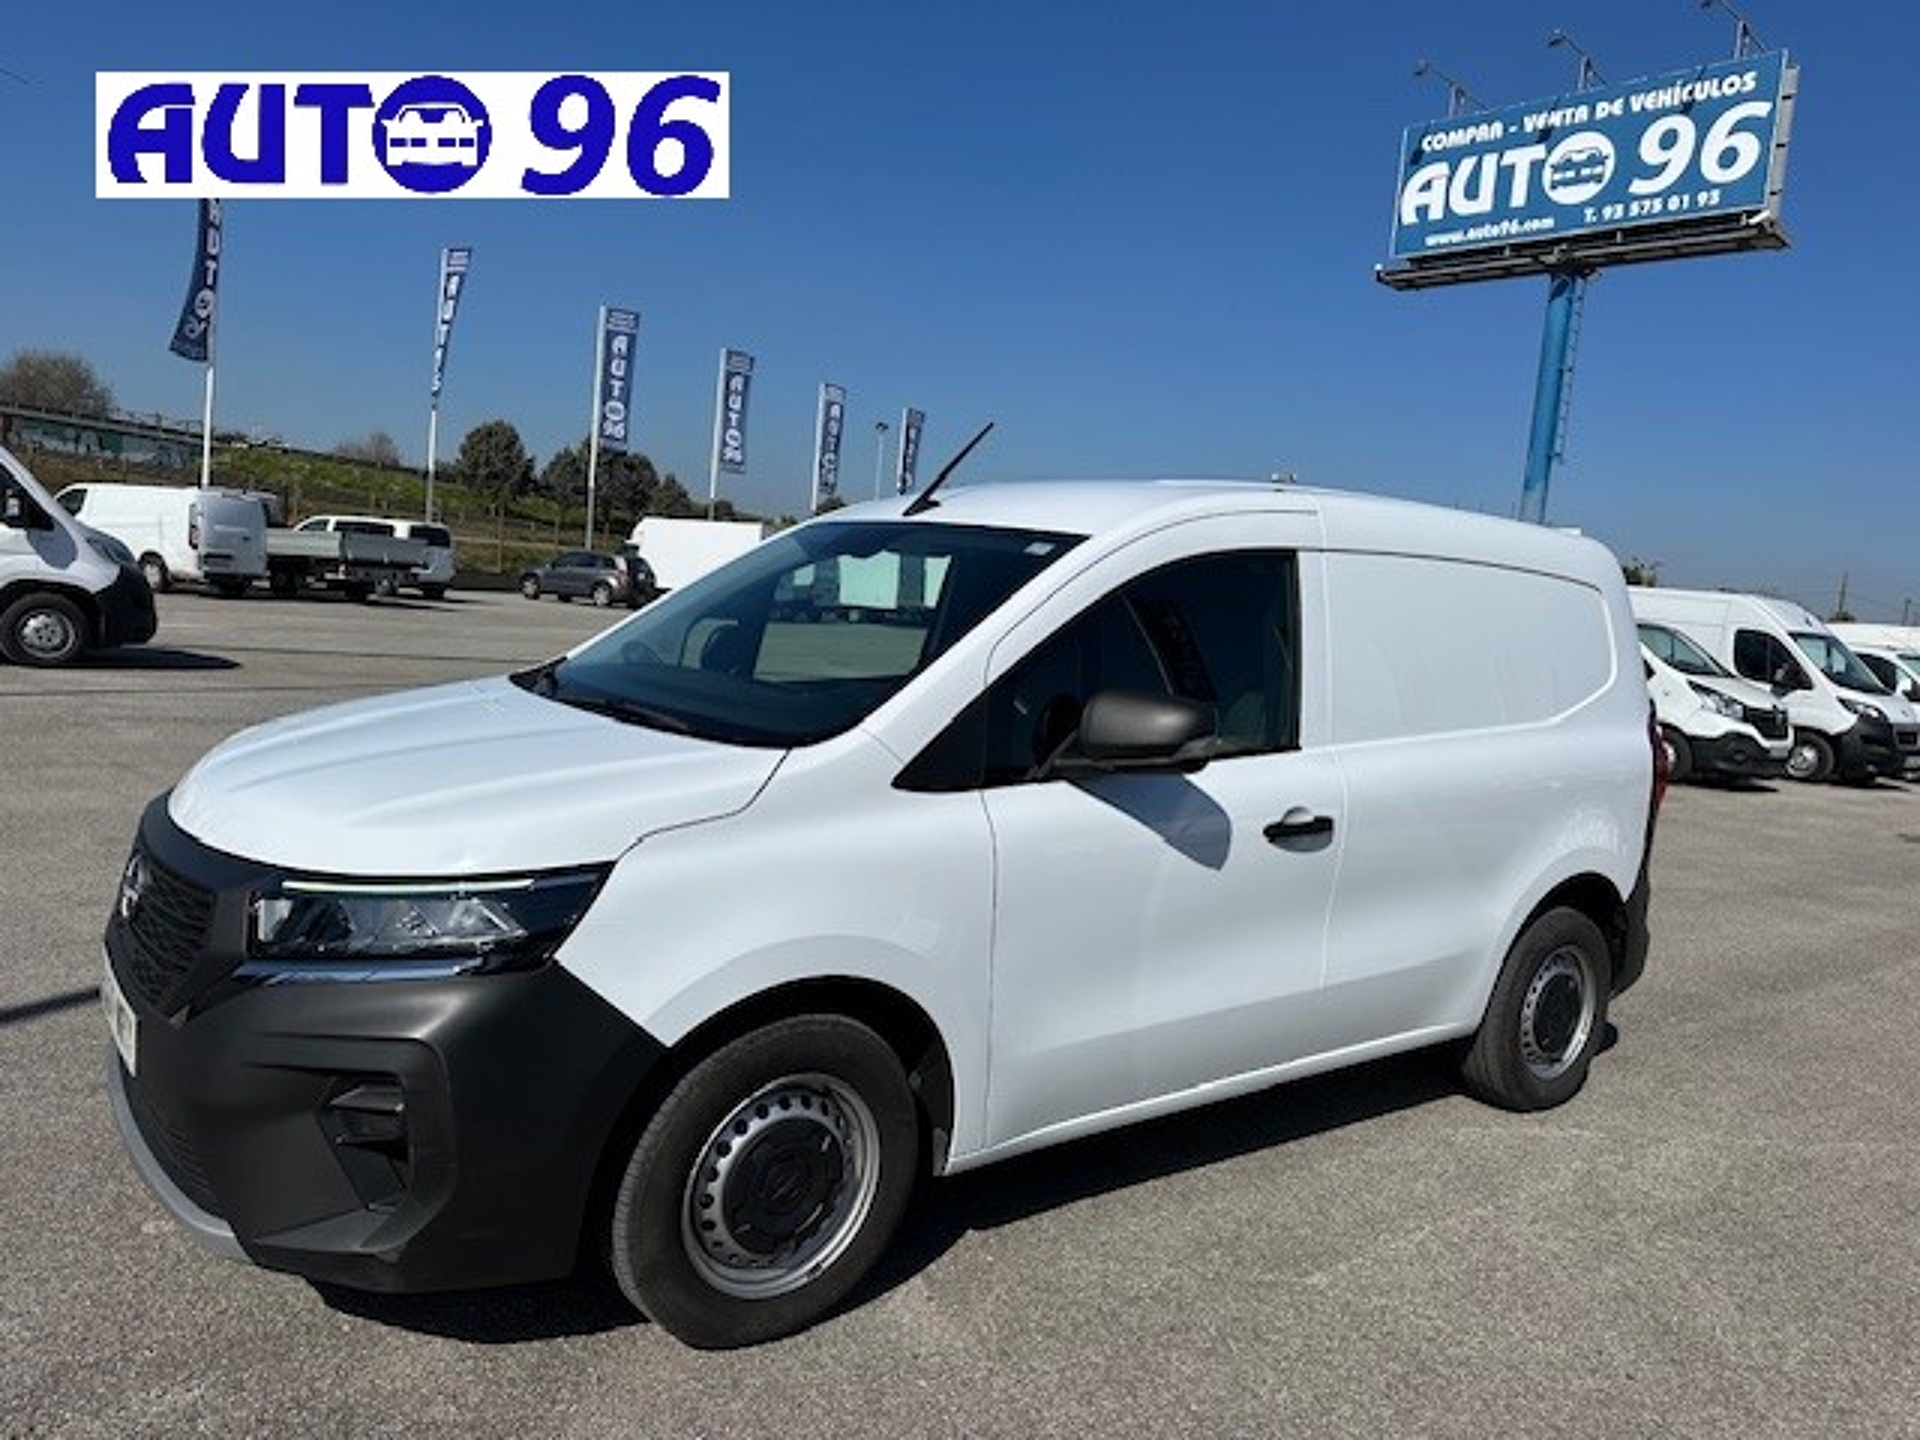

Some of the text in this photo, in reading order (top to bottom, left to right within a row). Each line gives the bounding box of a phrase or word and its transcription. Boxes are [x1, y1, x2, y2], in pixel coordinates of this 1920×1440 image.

[1523, 105, 1588, 132] VENTA
[1595, 98, 1624, 120] DE
[1631, 71, 1757, 112] VEHÍCULOS
[1400, 101, 1773, 226] AUTO 96
[604, 335, 629, 421] AUTO
